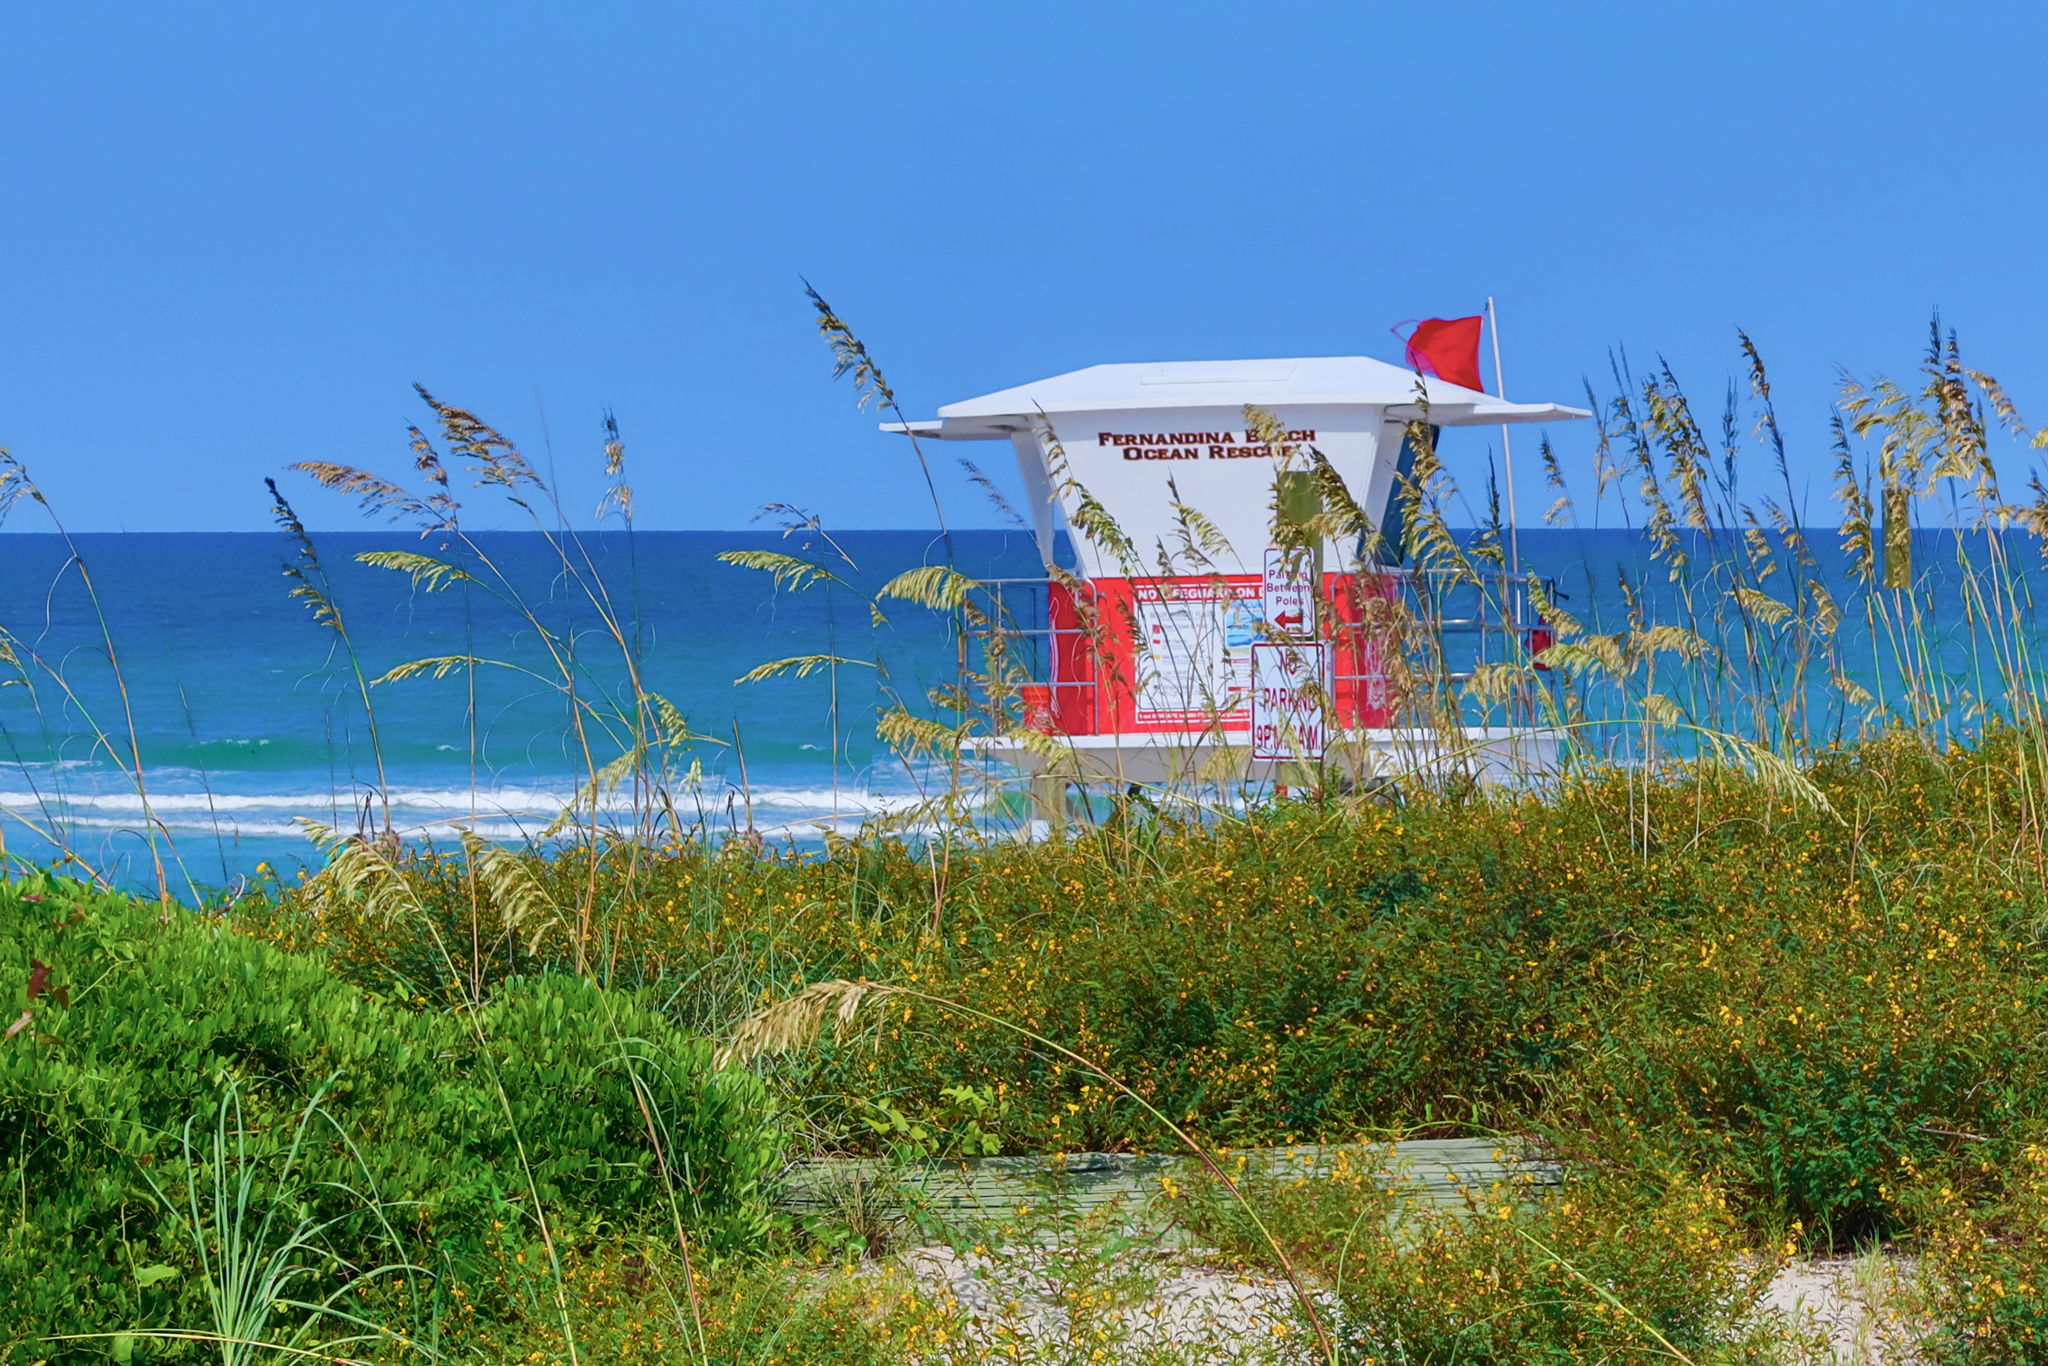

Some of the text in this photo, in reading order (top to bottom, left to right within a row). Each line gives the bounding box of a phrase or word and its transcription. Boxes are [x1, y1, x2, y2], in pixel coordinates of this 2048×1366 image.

[1098, 429, 1316, 446] FERNANDINA BCH
[1123, 446, 1199, 460] OCEAN
[1138, 589, 1157, 600] NO
[1236, 586, 1255, 598] ON
[1275, 596, 1304, 606] Poles
